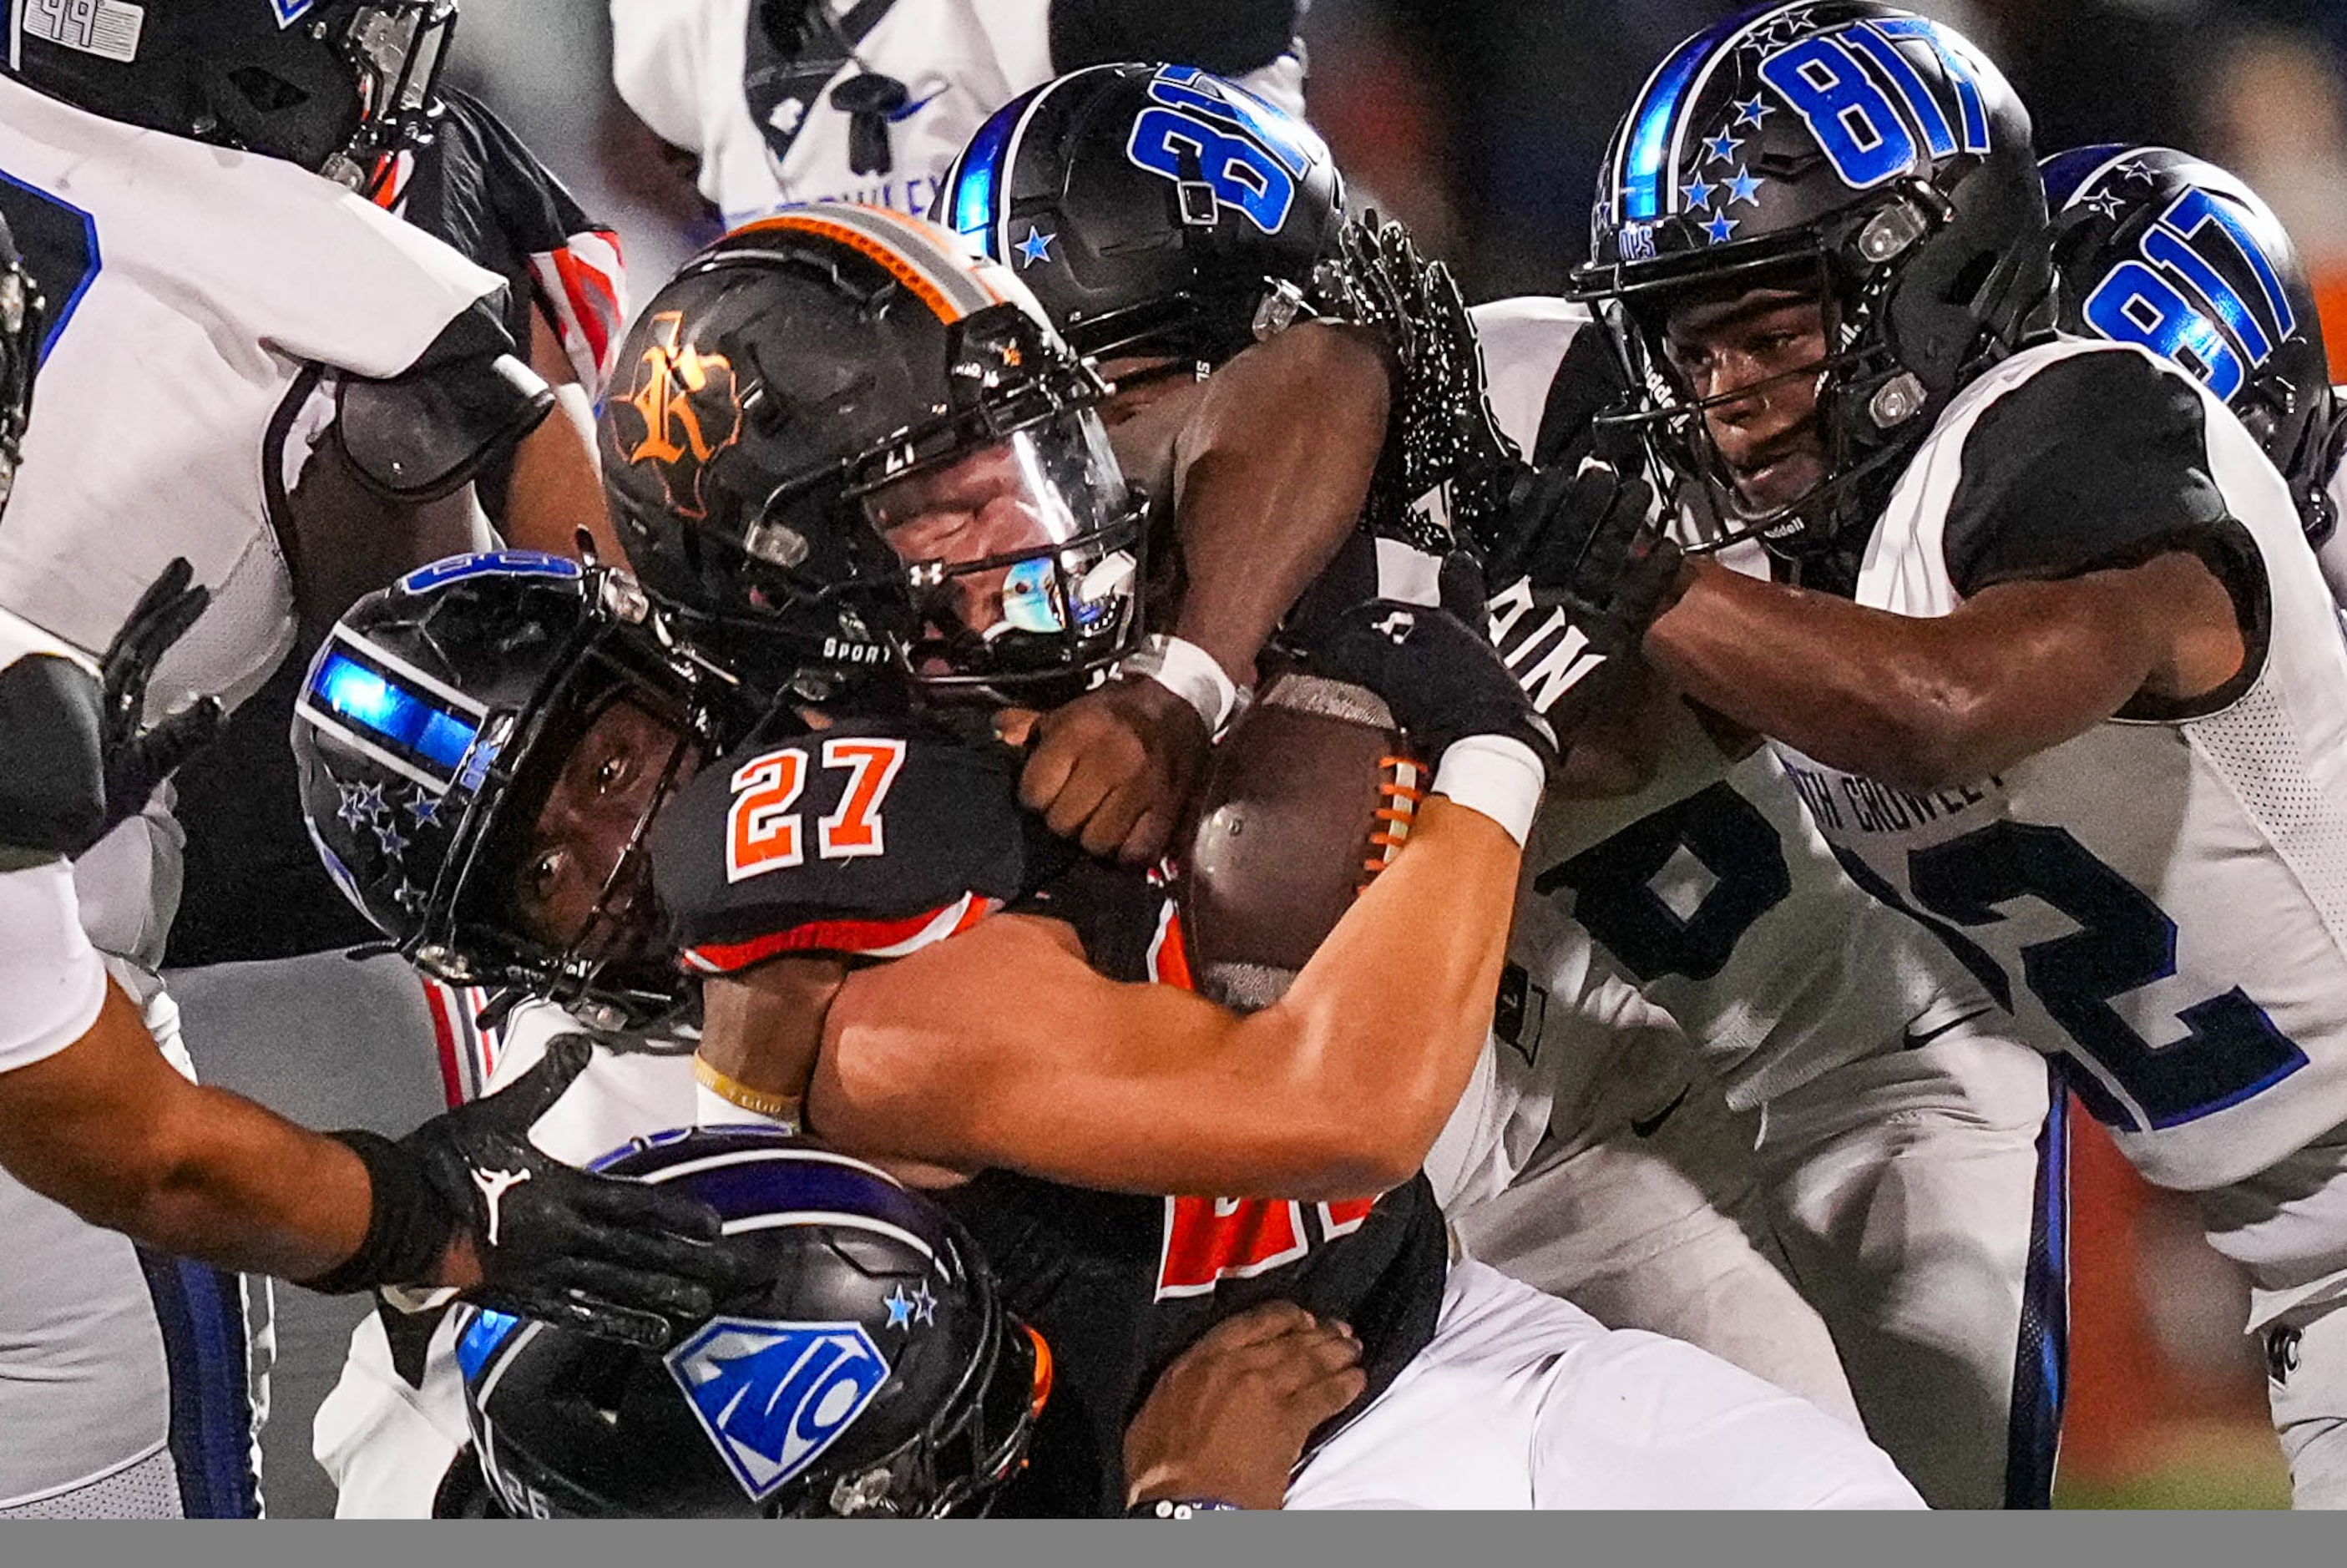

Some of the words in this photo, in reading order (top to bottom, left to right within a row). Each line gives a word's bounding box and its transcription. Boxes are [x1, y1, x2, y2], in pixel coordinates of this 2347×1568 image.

[1758, 17, 1991, 190] 817
[2082, 185, 2296, 404] 817
[726, 737, 907, 884] 27
